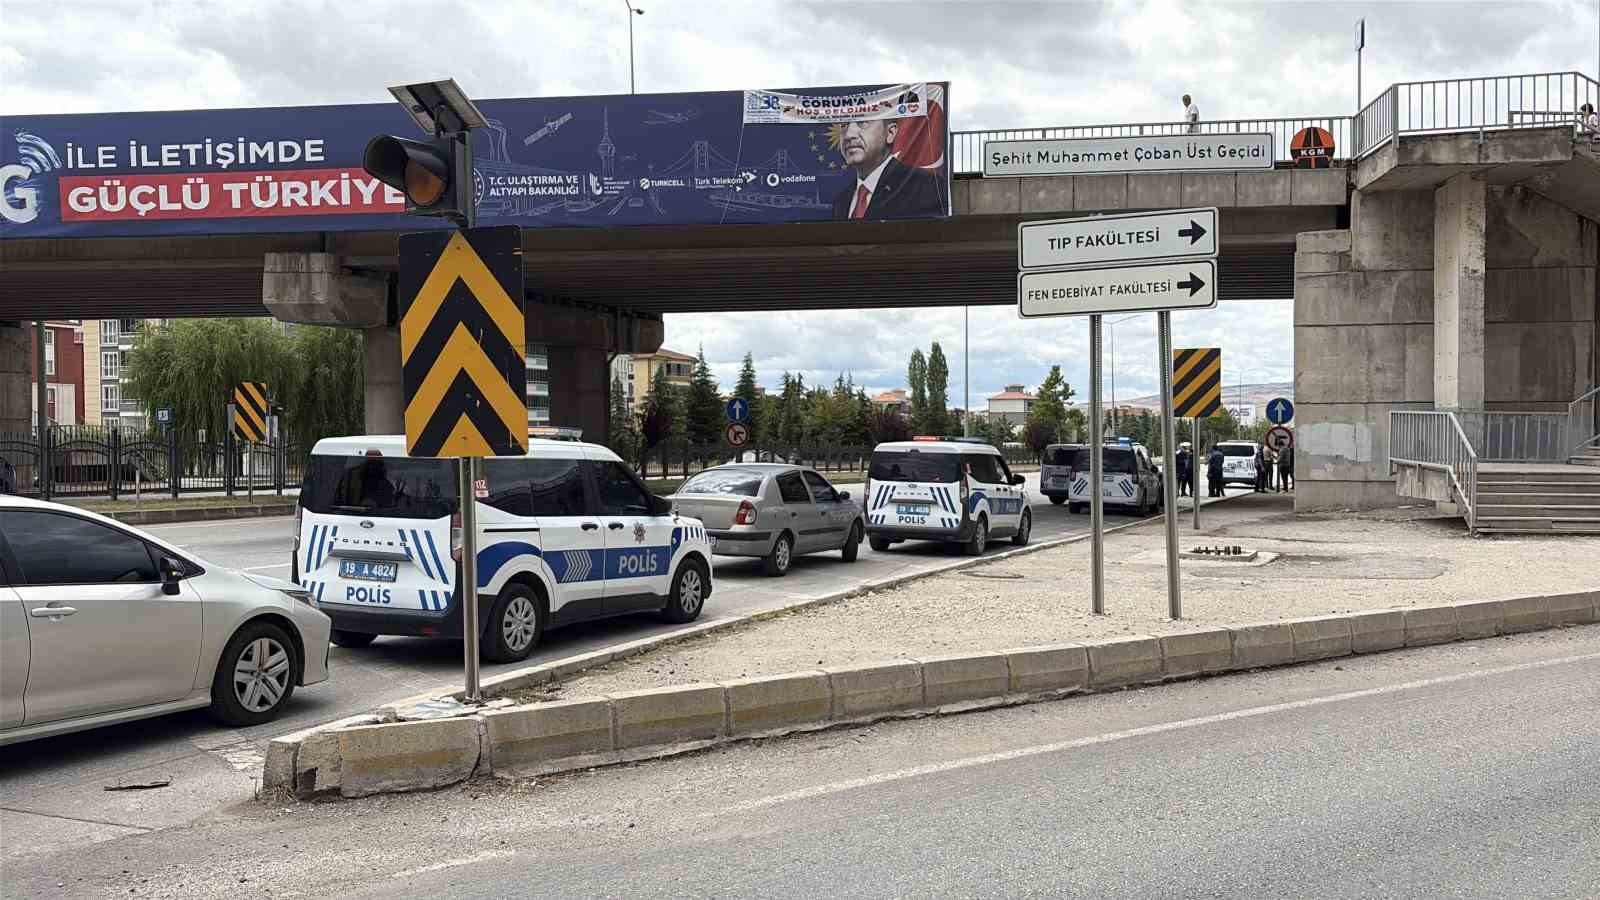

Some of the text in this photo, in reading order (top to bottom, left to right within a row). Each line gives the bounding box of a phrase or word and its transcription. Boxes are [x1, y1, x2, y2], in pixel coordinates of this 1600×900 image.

[66, 136, 325, 170] İLE İLETİŞİMDE
[992, 142, 1266, 167] Şehit Muhammet Çoban Üst Geçidi
[1300, 147, 1326, 158] KGM
[489, 175, 579, 186] T.C. ULAŞTIRMA VE
[712, 177, 744, 186] Telekom
[780, 174, 816, 183] vodafone
[67, 177, 211, 216] GÜÇLÜ
[489, 184, 579, 197] ALTYAPI BAKANLIĞI
[1048, 226, 1160, 251] TIP FAKÜLTESİ
[1028, 278, 1171, 301] FEN EDEBİYAT FAKÜLTESİ
[345, 562, 395, 577] 19 A 4824
[618, 549, 658, 575] POLİS
[346, 584, 391, 604] POLİS
